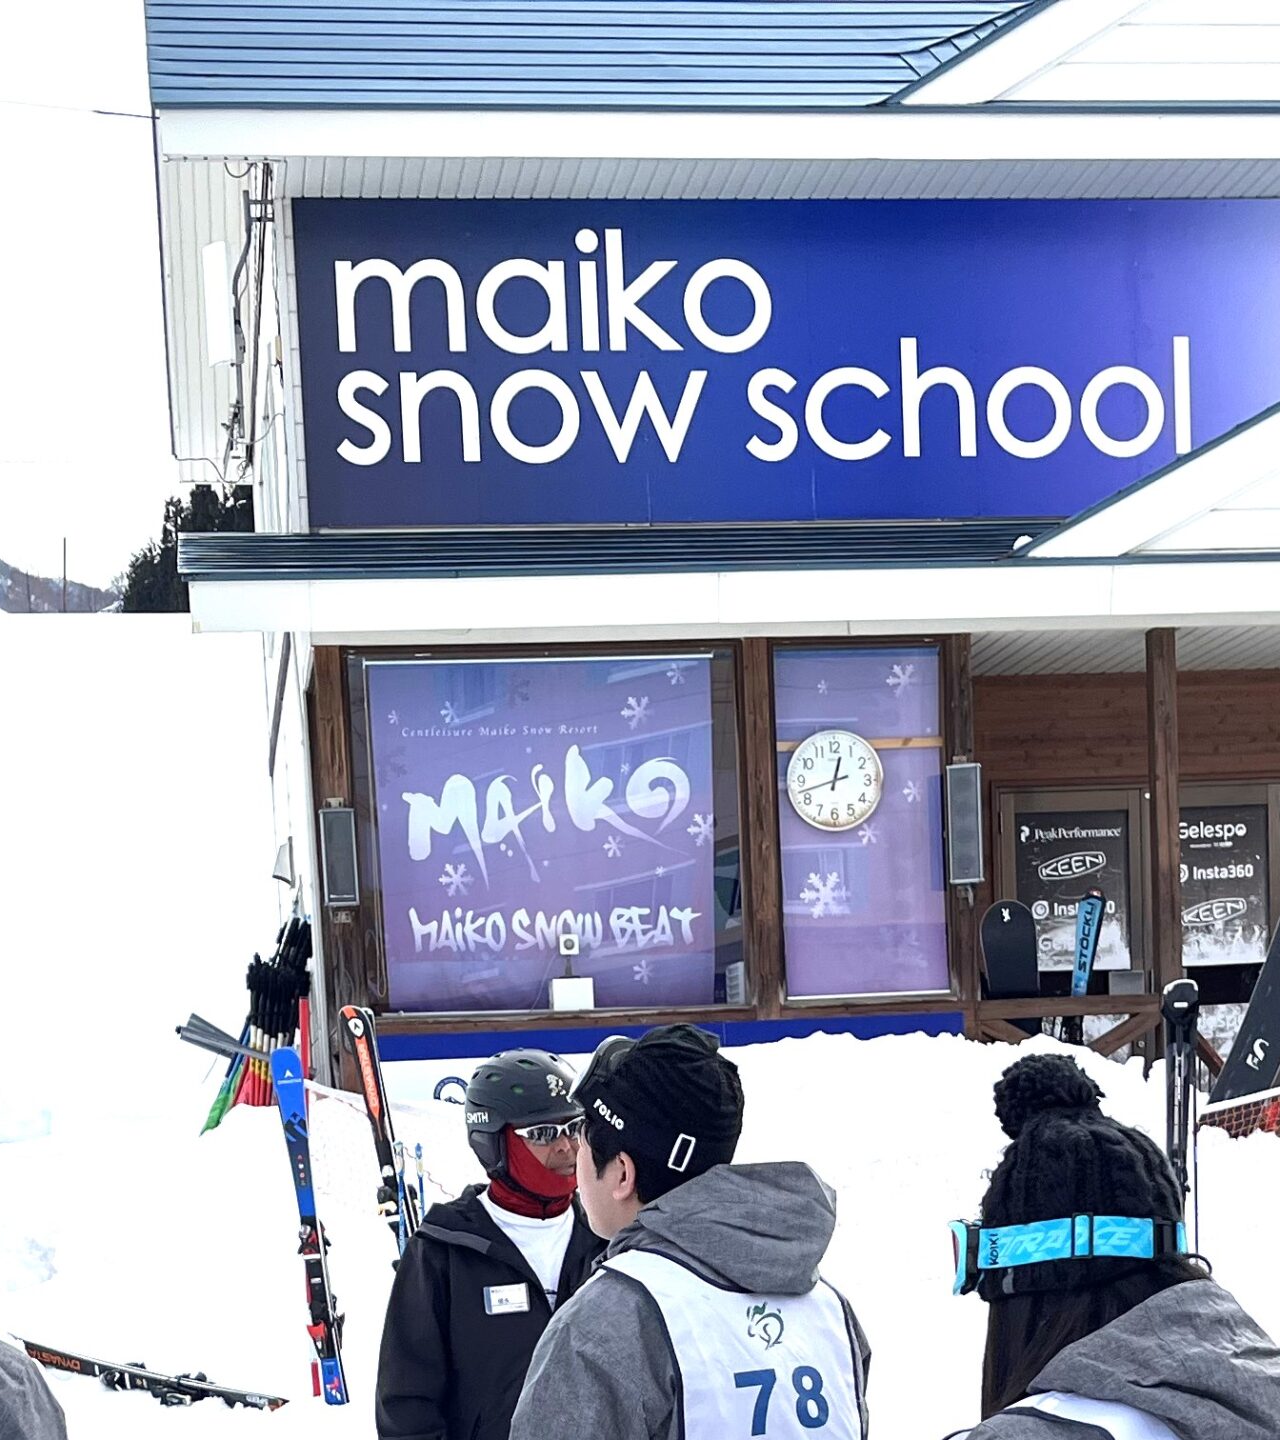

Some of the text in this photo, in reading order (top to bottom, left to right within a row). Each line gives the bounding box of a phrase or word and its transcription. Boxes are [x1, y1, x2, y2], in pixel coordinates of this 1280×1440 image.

[334, 228, 772, 354] maiko
[335, 335, 1191, 465] snow school
[522, 725, 552, 735] Snow
[815, 744, 824, 758] 11
[829, 741, 840, 754] 12
[849, 745, 853, 758] 1
[802, 757, 814, 770] 10
[858, 757, 866, 770] 2
[797, 774, 806, 787] 9
[864, 774, 872, 787] 3
[803, 792, 812, 806] 8
[858, 792, 867, 804] 4
[816, 804, 823, 816] 7
[831, 808, 839, 820] 6
[847, 804, 855, 816] 5
[1042, 855, 1103, 877] KEEN
[1193, 864, 1254, 880] Insta360
[1183, 901, 1243, 923] KEEN
[609, 905, 702, 947] BEAT
[467, 1111, 489, 1124] SMITH
[735, 1366, 829, 1437] 78
